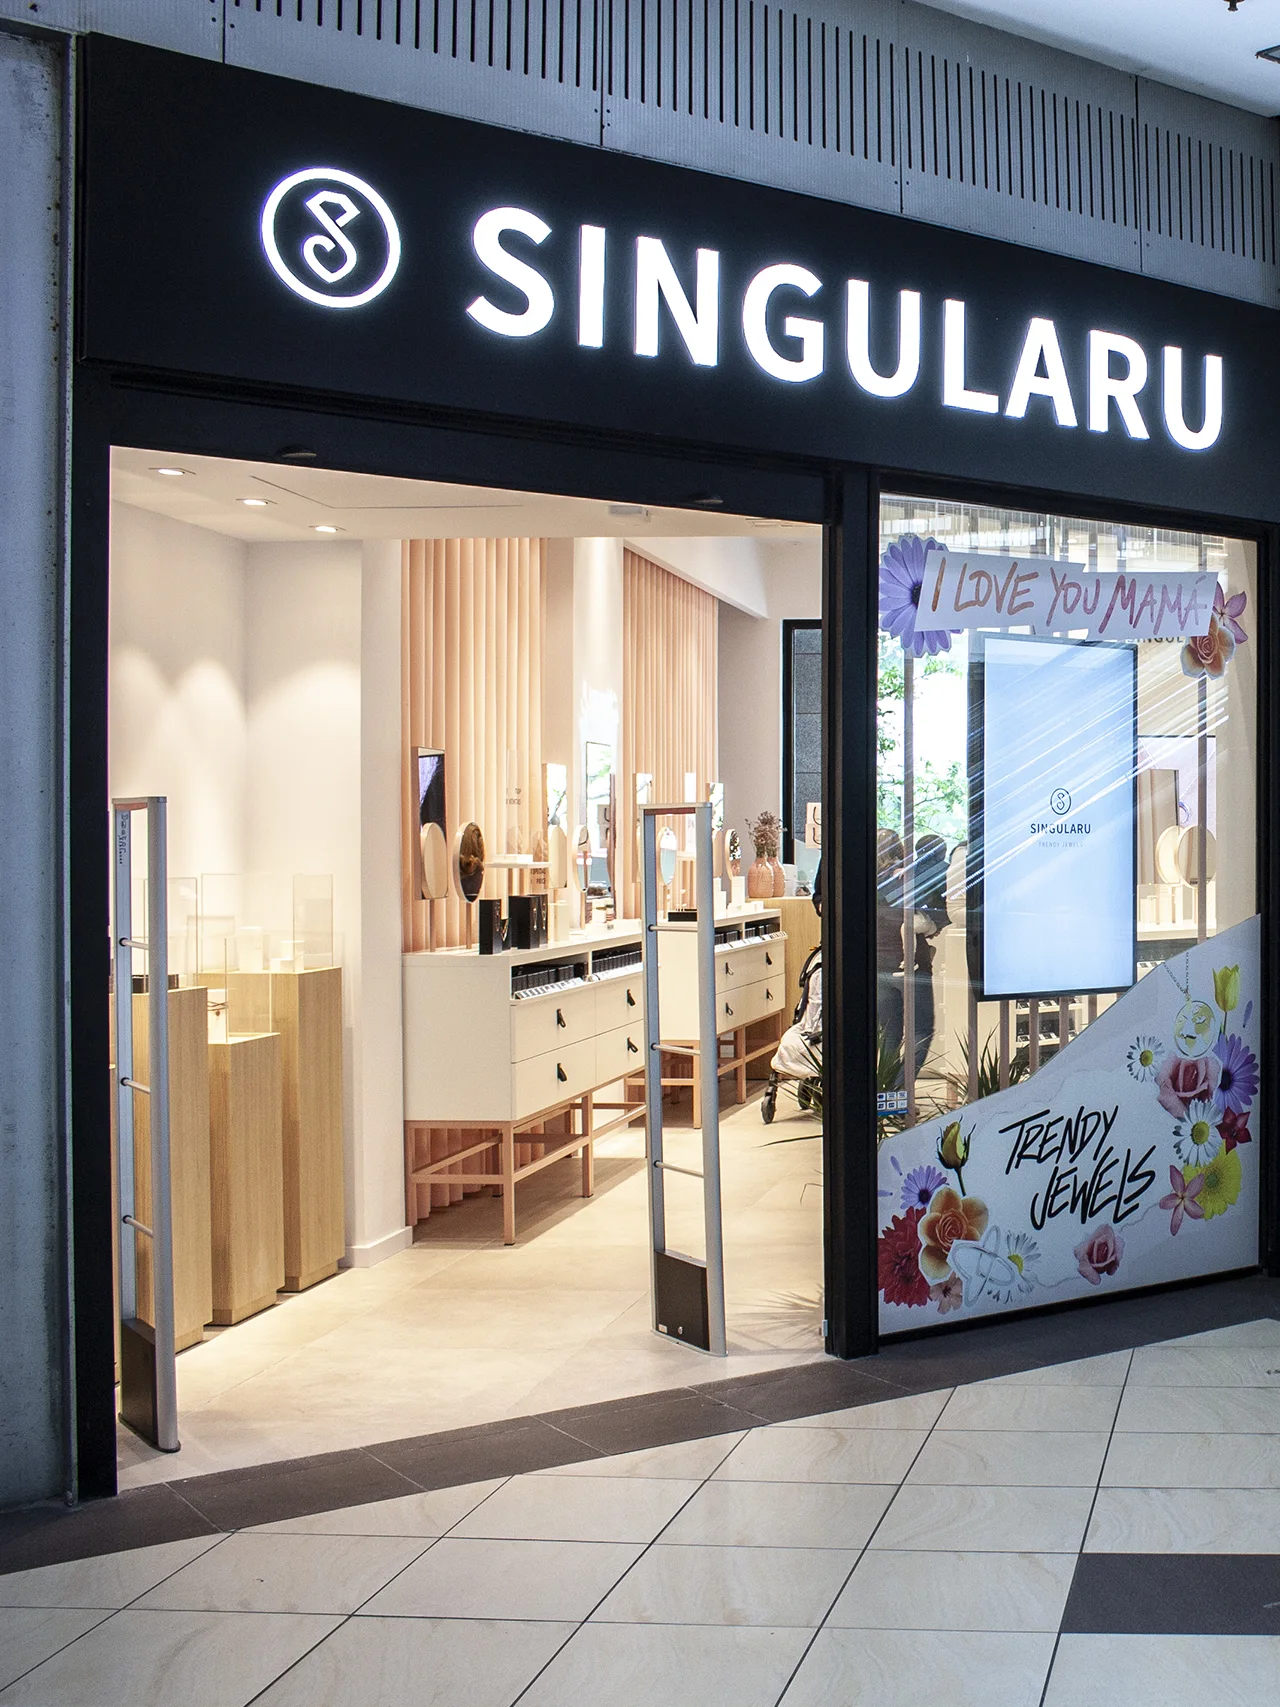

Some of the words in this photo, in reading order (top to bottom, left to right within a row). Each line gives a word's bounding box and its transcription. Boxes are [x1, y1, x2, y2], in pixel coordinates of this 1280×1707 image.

[466, 206, 1224, 452] SINGULARU
[931, 556, 947, 613] I
[954, 561, 1039, 615] LOVE
[1046, 567, 1101, 627] YOU
[1030, 823, 1091, 834] SINGULARU
[999, 1105, 1119, 1175] TRENDY
[1030, 1145, 1157, 1231] JEWELS
